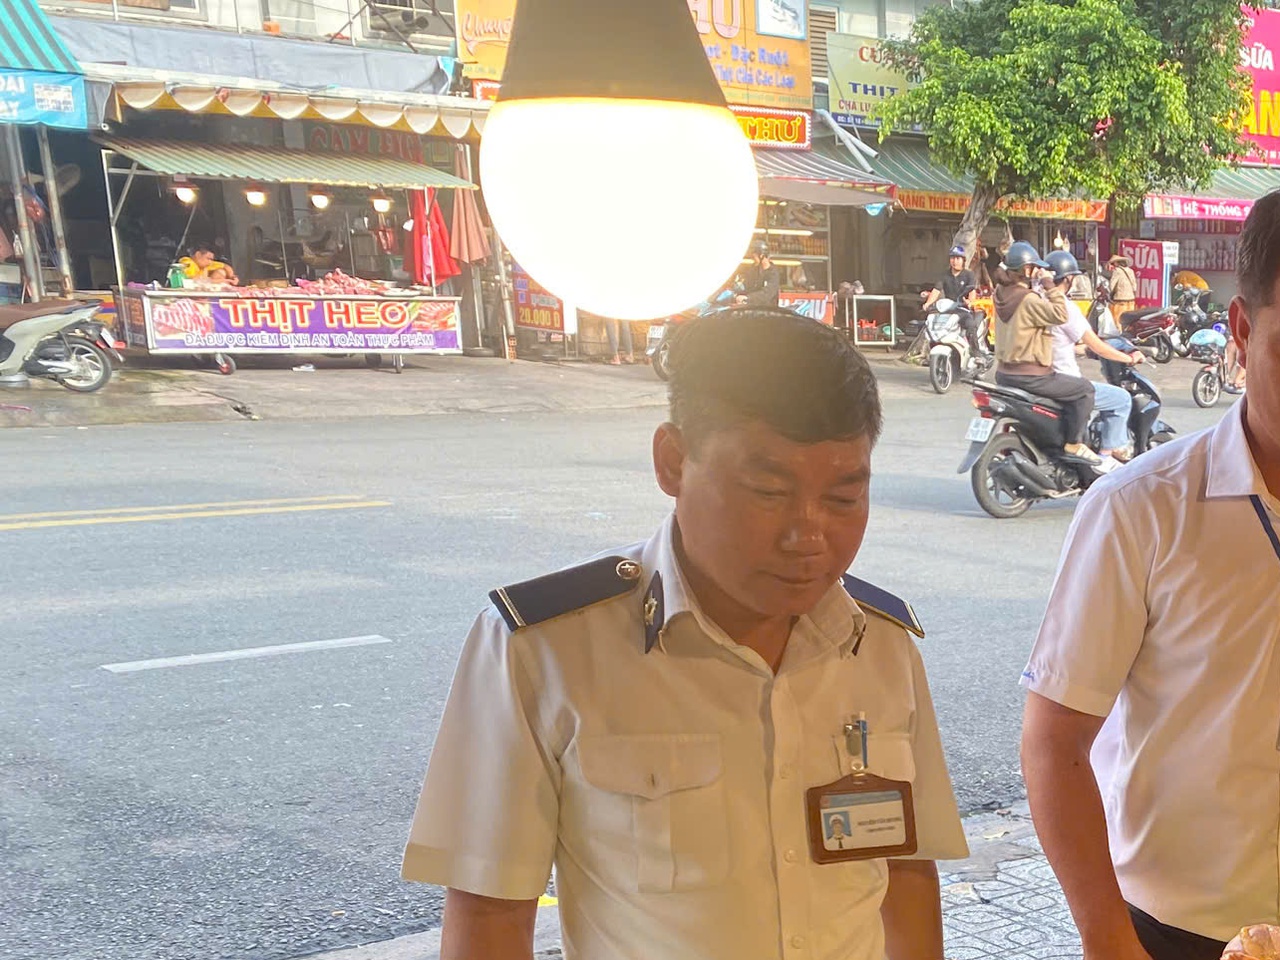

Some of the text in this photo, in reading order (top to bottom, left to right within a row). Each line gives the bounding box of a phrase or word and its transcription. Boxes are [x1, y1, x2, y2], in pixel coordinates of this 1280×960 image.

[1183, 202, 1199, 218] HỆ
[1202, 201, 1242, 217] THỐNG
[1122, 244, 1160, 270] SỮA
[219, 299, 410, 333] THỊT HEO
[312, 333, 330, 346] AN
[331, 331, 364, 346] TOÀN
